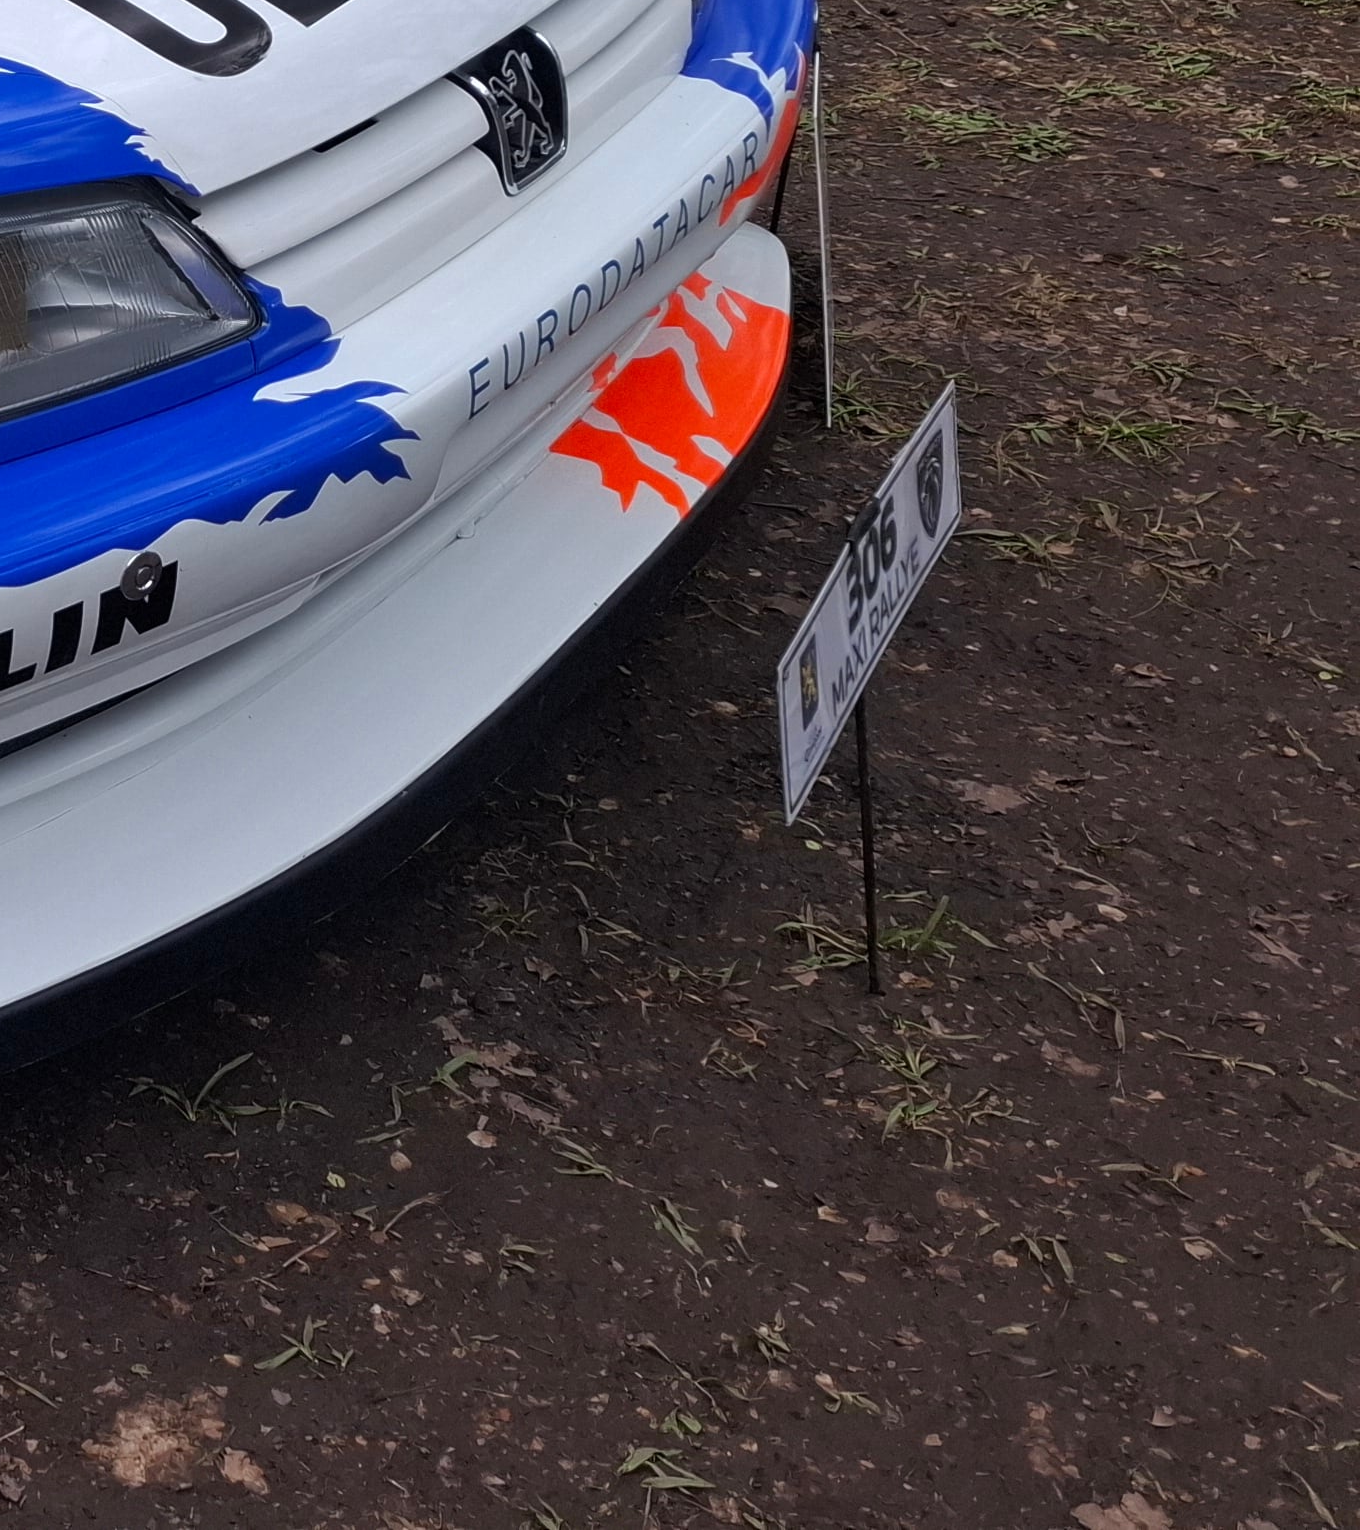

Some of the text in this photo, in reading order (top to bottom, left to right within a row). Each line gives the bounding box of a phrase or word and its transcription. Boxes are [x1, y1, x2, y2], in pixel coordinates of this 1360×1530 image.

[467, 129, 761, 422] EURODATACAR
[832, 535, 921, 719] MAXI RALLYE
[847, 494, 898, 635] 306
